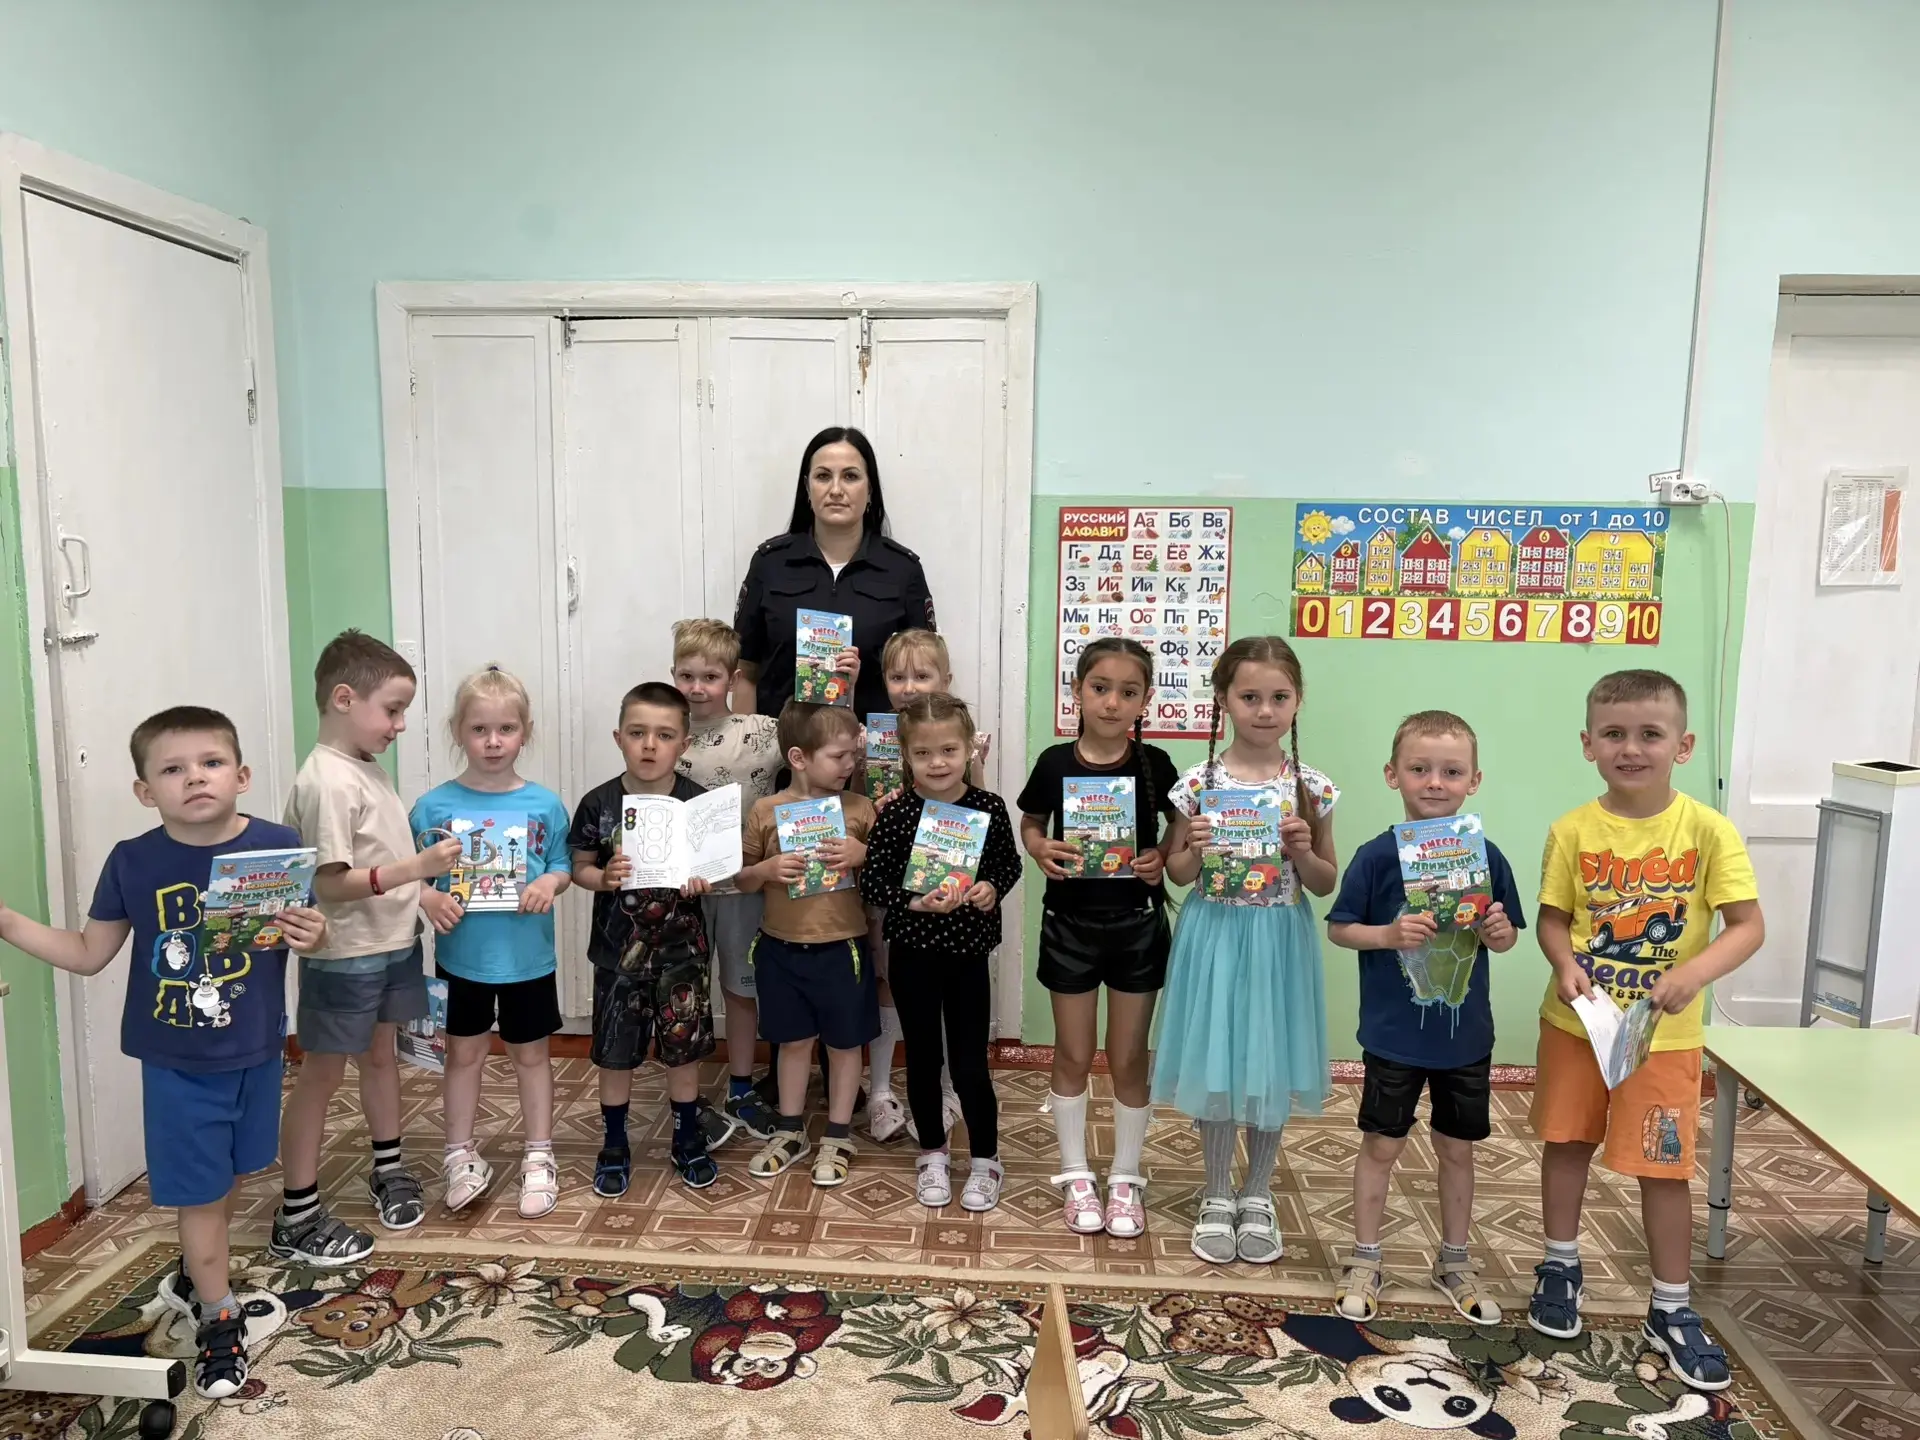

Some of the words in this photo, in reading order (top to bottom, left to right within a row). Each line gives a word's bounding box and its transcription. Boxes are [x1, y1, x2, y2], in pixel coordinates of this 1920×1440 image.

[1063, 511, 1126, 524] РУССКИЙ
[1134, 512, 1155, 528] Аа
[1169, 512, 1191, 528] Бб
[1203, 512, 1224, 528] Вв
[1358, 508, 1449, 524] СОСТАВ
[1466, 509, 1542, 526] ЧИСЕЛ
[1560, 513, 1582, 525] от
[1589, 510, 1598, 526] 1
[1608, 514, 1635, 529] до
[1643, 510, 1665, 527] 10
[1062, 526, 1126, 537] АЛФАВИТ
[1068, 544, 1082, 559] Гг
[1097, 545, 1121, 560] Дд
[1133, 545, 1153, 560] Ее
[1167, 542, 1188, 560] Ёё
[1199, 545, 1225, 560] Жж
[1065, 576, 1086, 591] Зз
[1098, 577, 1119, 591] Ии
[1132, 576, 1153, 591] Йй
[1166, 577, 1186, 592] Кк
[1197, 577, 1218, 592] Лл
[1063, 608, 1089, 623] Мм
[1099, 608, 1118, 623] Нн
[1130, 609, 1152, 624] Оо
[1164, 609, 1185, 624] Пп
[1198, 610, 1218, 627] Рр
[1302, 600, 1325, 633] 0
[1336, 600, 1354, 634] 1
[1365, 601, 1391, 635] 2
[1399, 601, 1424, 635] 3
[1429, 602, 1454, 635] 4
[1465, 602, 1490, 636] 5
[1498, 603, 1523, 637] 6
[1534, 604, 1558, 638] 7
[1567, 604, 1591, 638] 8
[1600, 604, 1624, 639] 9
[1628, 605, 1659, 640] 10
[1160, 640, 1188, 657] Фф
[1197, 641, 1218, 656] Хх
[1159, 672, 1188, 688] Щщ
[1158, 704, 1187, 719] Юю
[1579, 847, 1699, 894] Shred
[1651, 946, 1678, 958] The
[1575, 953, 1673, 990] Beac
